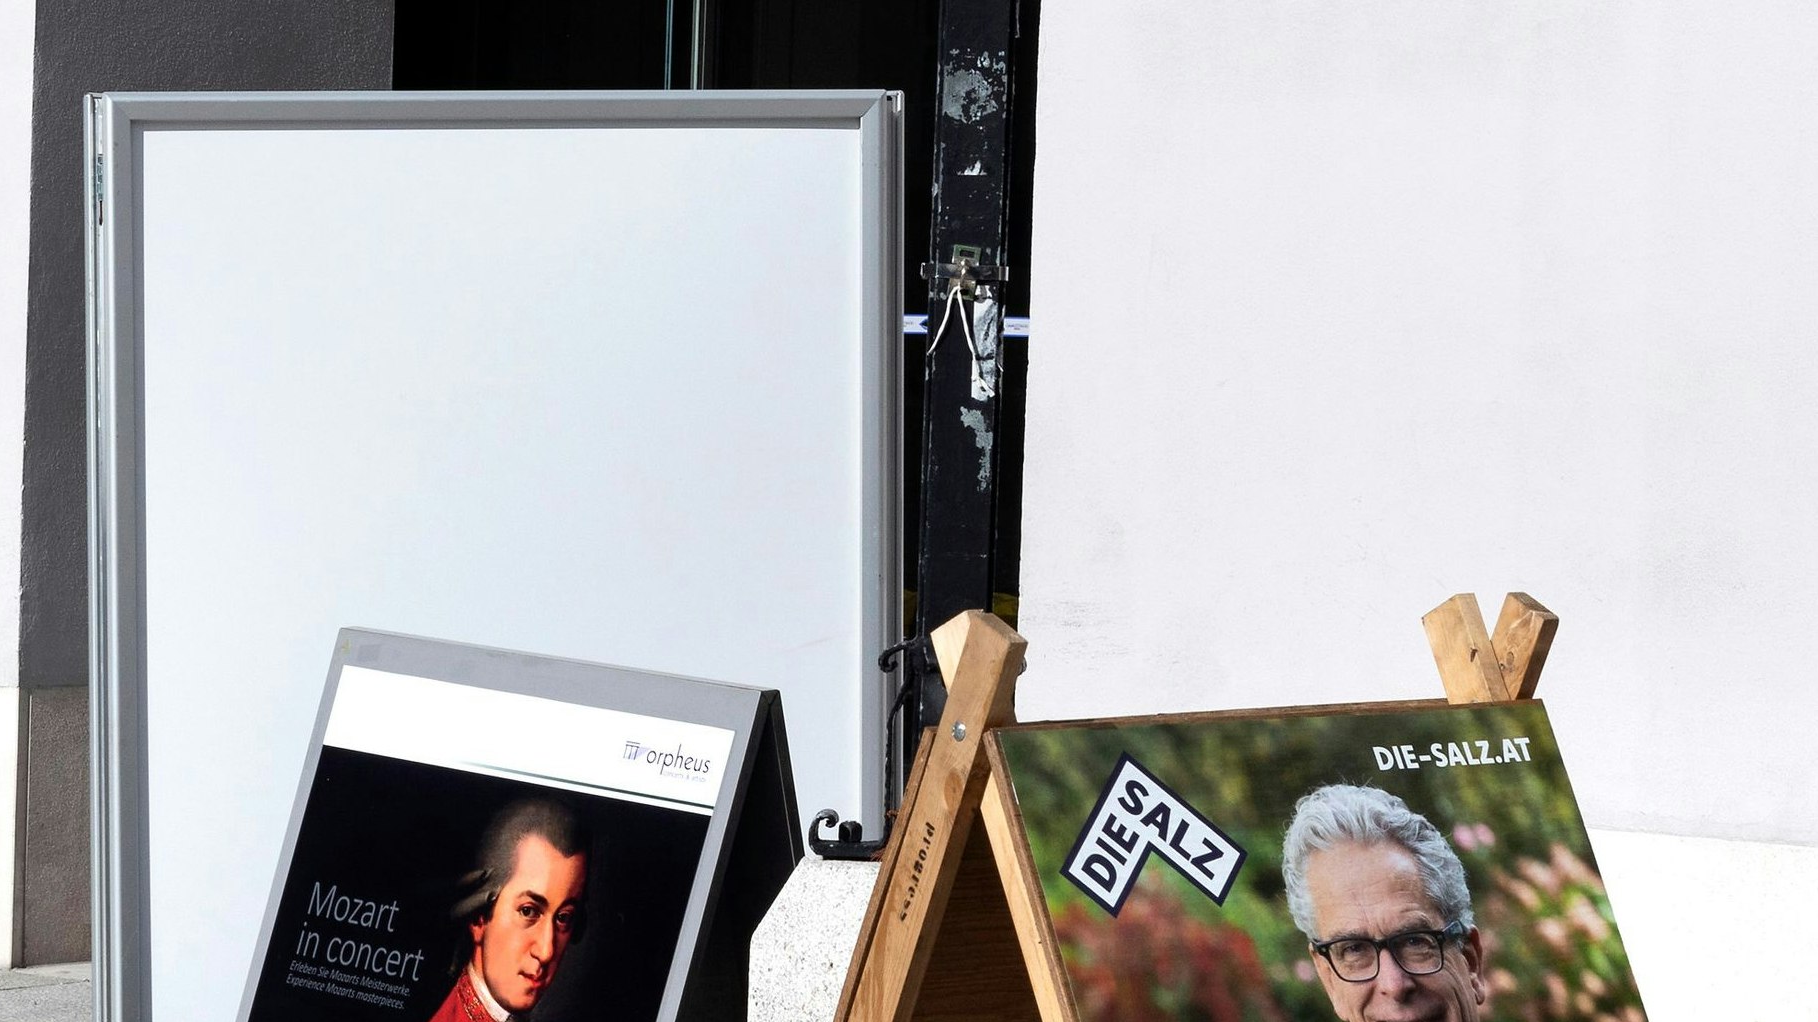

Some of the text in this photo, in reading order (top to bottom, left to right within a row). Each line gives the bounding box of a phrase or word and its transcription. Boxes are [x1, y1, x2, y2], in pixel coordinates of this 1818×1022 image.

[646, 743, 710, 775] orpheus
[1373, 737, 1533, 771] DIE-SALZ.AT
[1081, 814, 1139, 893] DIE
[1117, 779, 1225, 880] SALZ
[901, 821, 935, 922] progress
[307, 881, 400, 932] Mozart
[296, 921, 424, 981] in concert
[286, 973, 405, 1010] Experience Mozarts masterpieces.
[289, 960, 411, 997] Erleben Sie Mozarts Meisterwerke.
